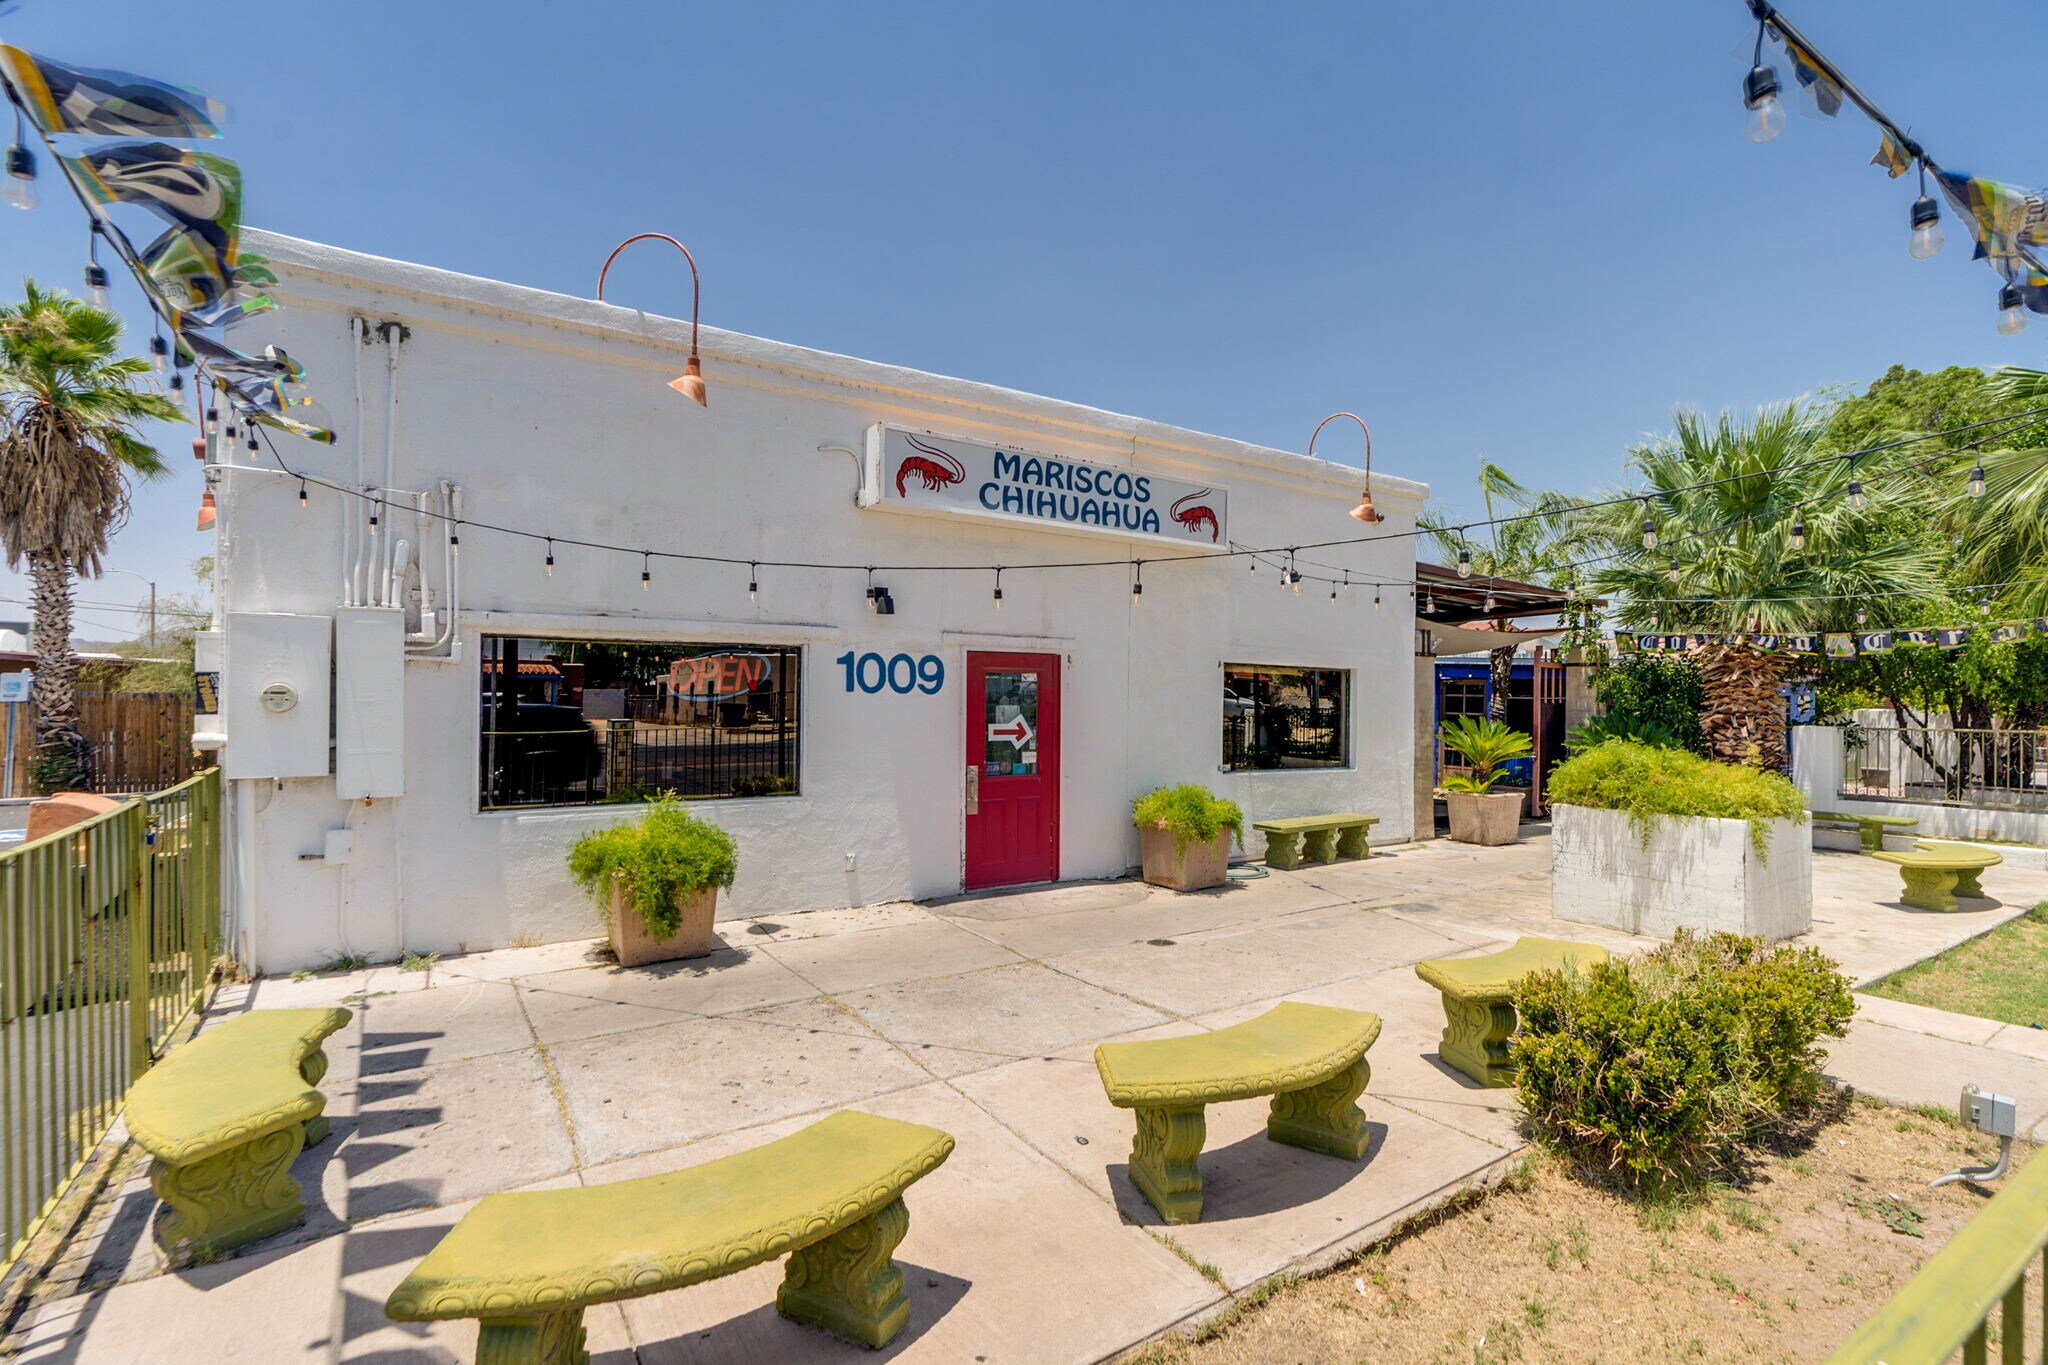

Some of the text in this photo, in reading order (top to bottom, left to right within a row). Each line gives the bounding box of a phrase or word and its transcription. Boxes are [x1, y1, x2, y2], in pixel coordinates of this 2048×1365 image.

[993, 451, 1151, 503] MARISCOS
[978, 482, 1160, 534] CHIHUAHUA
[670, 657, 763, 692] OPEN
[836, 650, 945, 695] 1009
